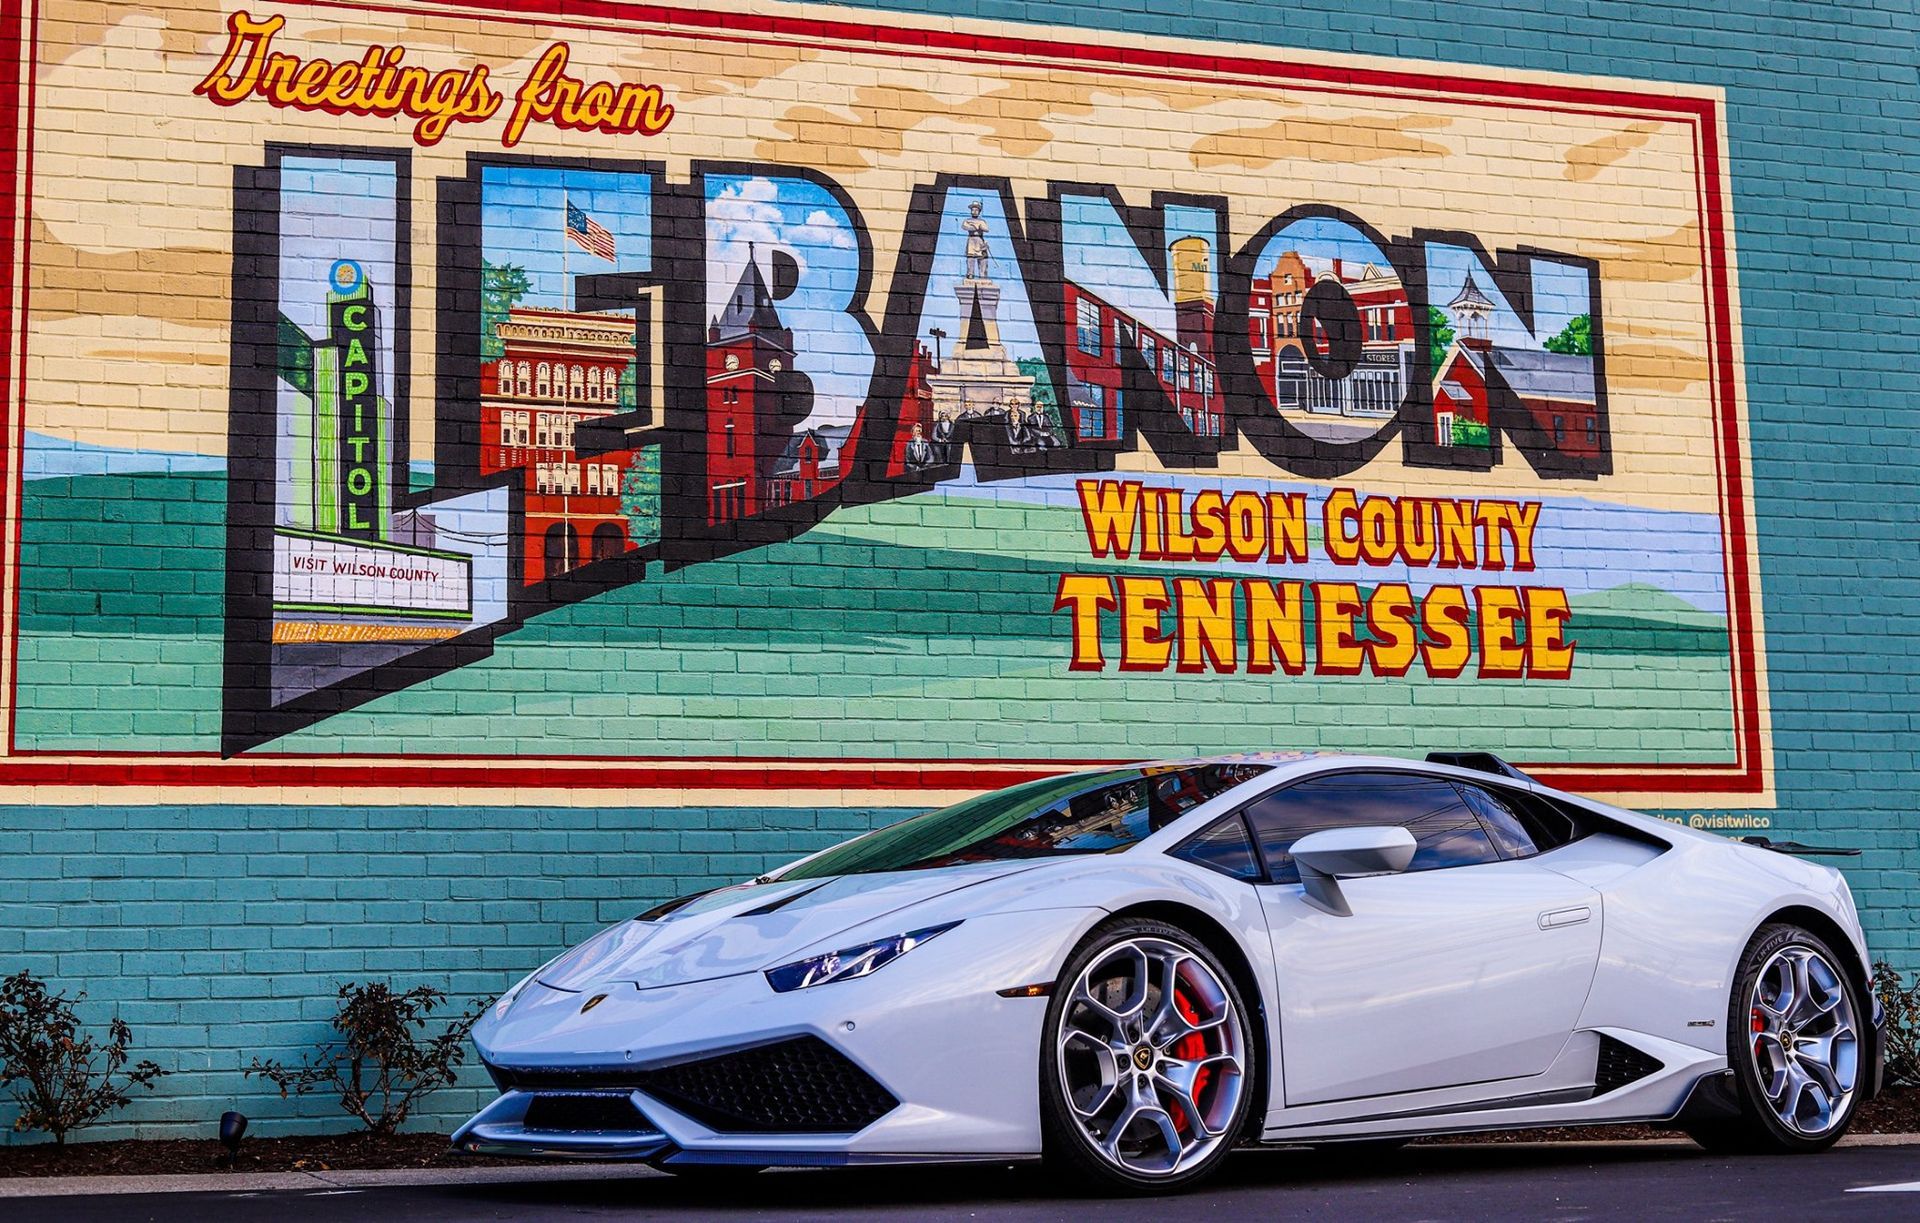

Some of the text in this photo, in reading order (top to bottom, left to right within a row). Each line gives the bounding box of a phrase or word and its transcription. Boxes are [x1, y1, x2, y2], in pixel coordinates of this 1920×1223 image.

[192, 10, 675, 147] Greetings from
[1366, 353, 1396, 363] STORES
[223, 141, 1613, 758] LEBANON
[342, 304, 373, 530] CAPITOL
[293, 556, 440, 582] VISIT WILSON COUNTY
[1076, 479, 1542, 571] WILSON COUNTY
[1054, 573, 1576, 680] TENNESSEE
[1689, 813, 1770, 829] @visitwilco
